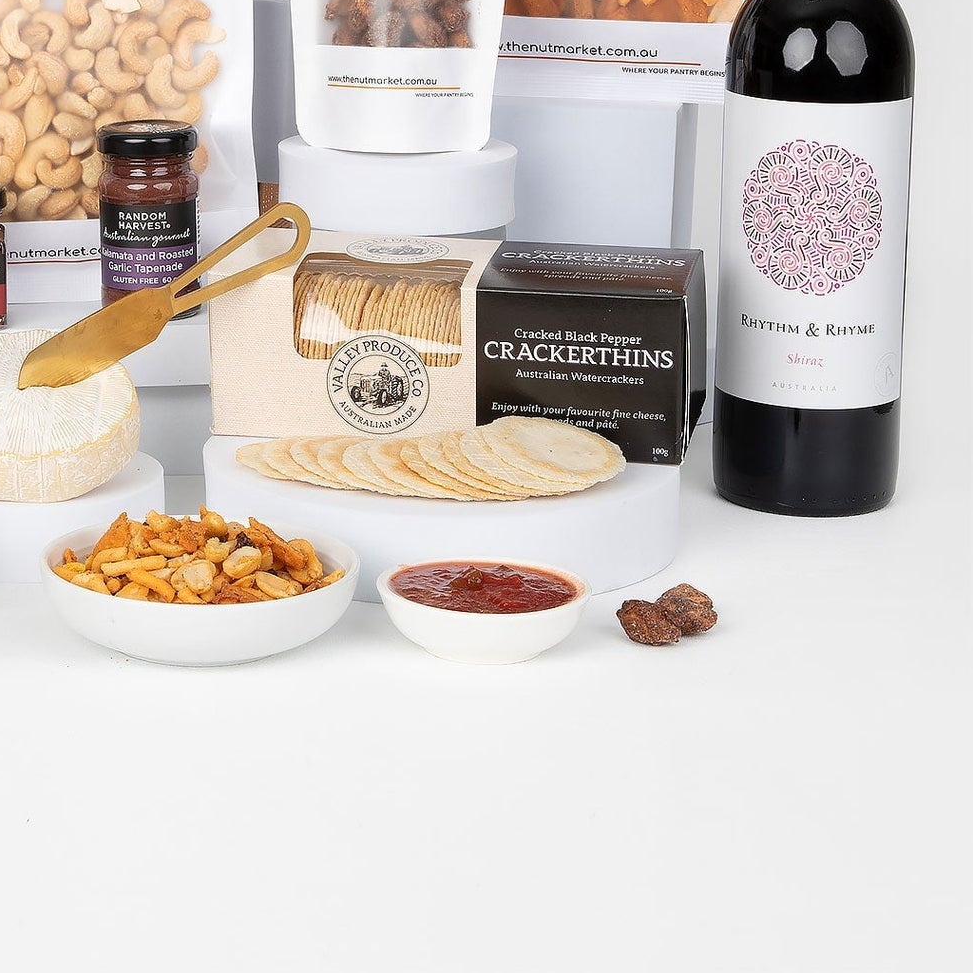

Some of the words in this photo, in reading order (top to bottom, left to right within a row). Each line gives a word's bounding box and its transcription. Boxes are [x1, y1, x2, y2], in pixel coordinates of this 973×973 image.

[621, 66, 647, 74] WHERE
[670, 68, 698, 76] PANTRY
[700, 69, 726, 77] BEGINS
[327, 74, 438, 86] www.thenutmarket.com.au
[118, 211, 167, 221] RANDOM
[103, 226, 151, 242] Australian
[136, 251, 156, 261] and
[159, 246, 194, 260] Roasted
[501, 252, 686, 267] CRACKERTHINS
[108, 261, 132, 273] Garlic
[134, 261, 183, 274] Tapenade
[113, 275, 137, 284] GLUTEN
[514, 327, 562, 341] Cracked
[564, 331, 598, 344] Black
[600, 333, 642, 347] Pepper
[805, 323, 820, 337] &
[483, 340, 674, 369] CRACKERTHINS
[786, 353, 826, 368] Shiraz
[332, 344, 361, 393] VALLEY
[362, 340, 421, 377] PRODUCE
[515, 368, 569, 381] Australian
[571, 371, 644, 385] Watercrackers
[771, 381, 838, 392] AUSTRALIA
[339, 401, 392, 429] AUSTRALIAN
[394, 406, 417, 426] MADE
[491, 402, 518, 413] Enjoy
[520, 404, 541, 413] with
[543, 406, 566, 415] your
[566, 406, 611, 418] favourite
[612, 409, 631, 420] fine
[633, 411, 667, 422] cheese,
[575, 419, 594, 428] and
[652, 447, 669, 457] 100g
